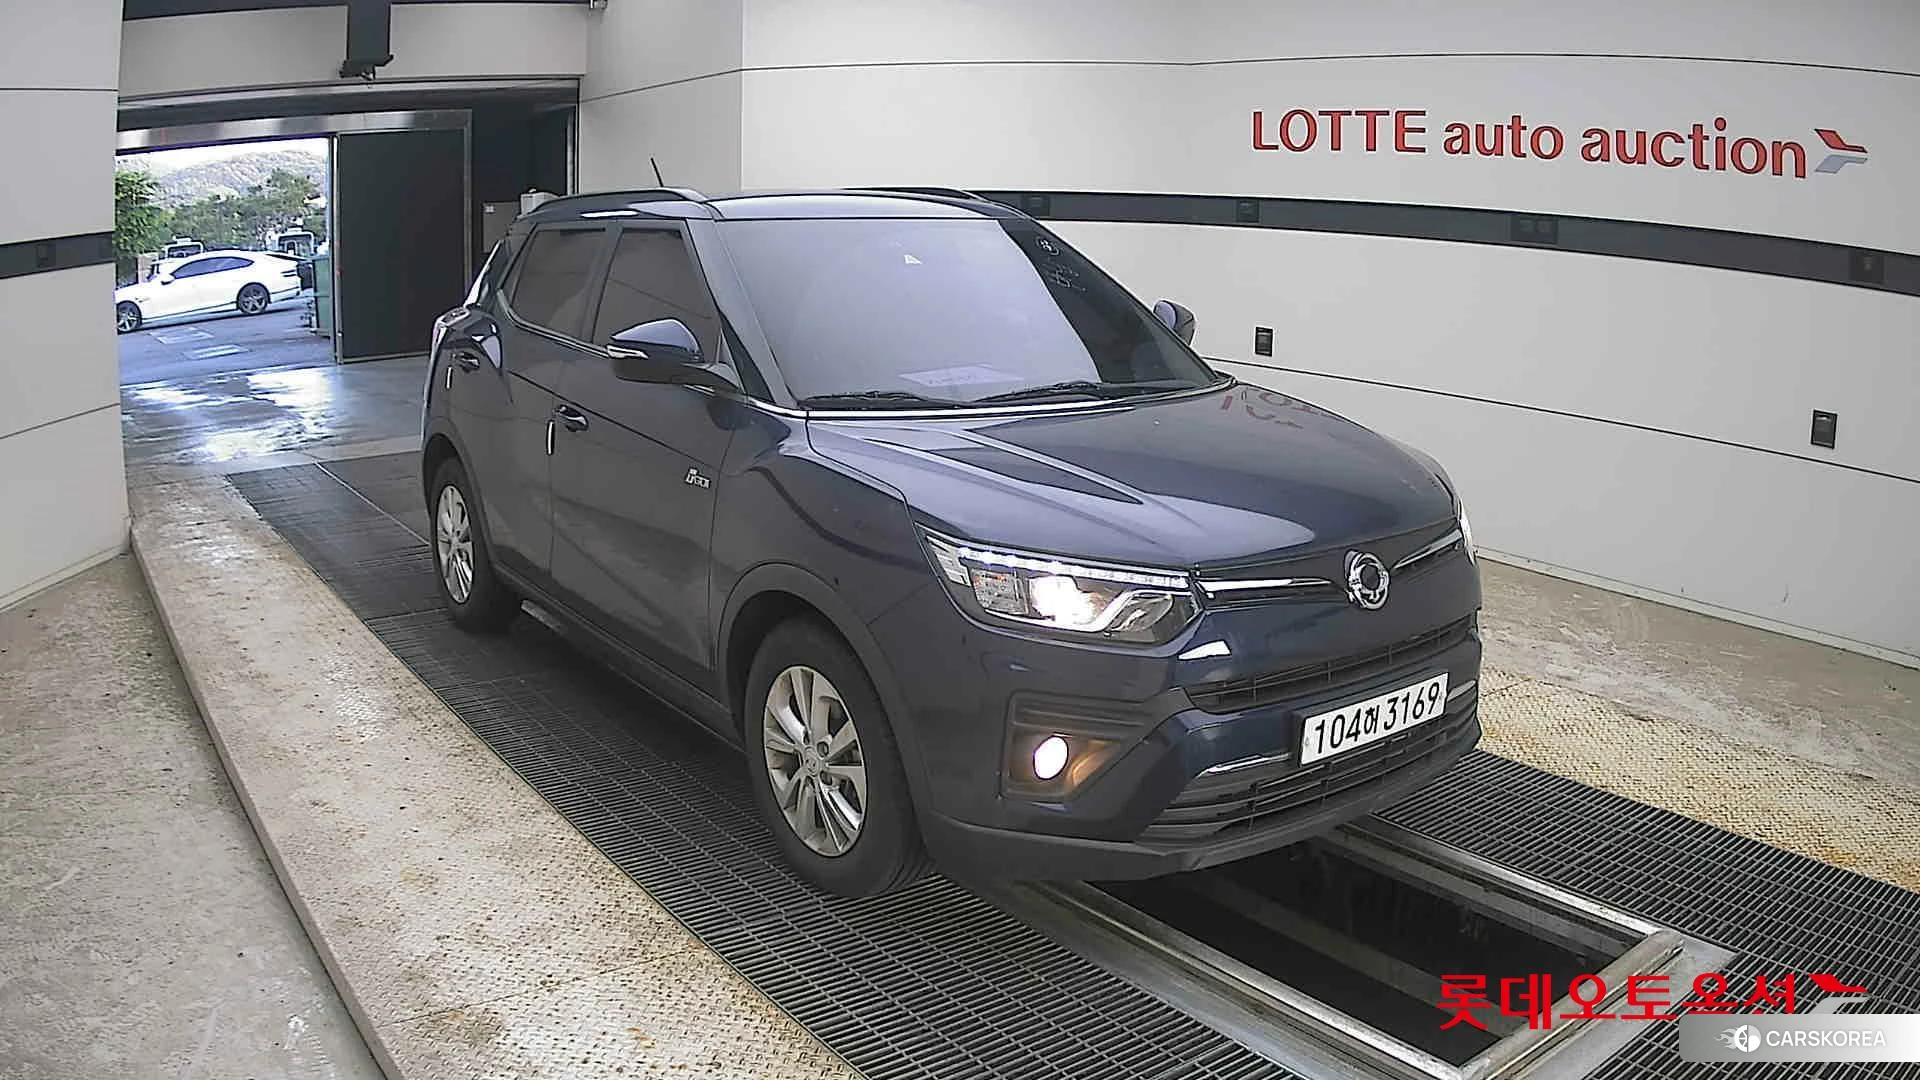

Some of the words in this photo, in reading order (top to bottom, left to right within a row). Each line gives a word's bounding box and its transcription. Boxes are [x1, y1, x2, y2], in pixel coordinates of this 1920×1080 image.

[1252, 109, 1427, 153] LOTTE
[1443, 115, 1565, 160] auto
[1580, 117, 1808, 179] auction
